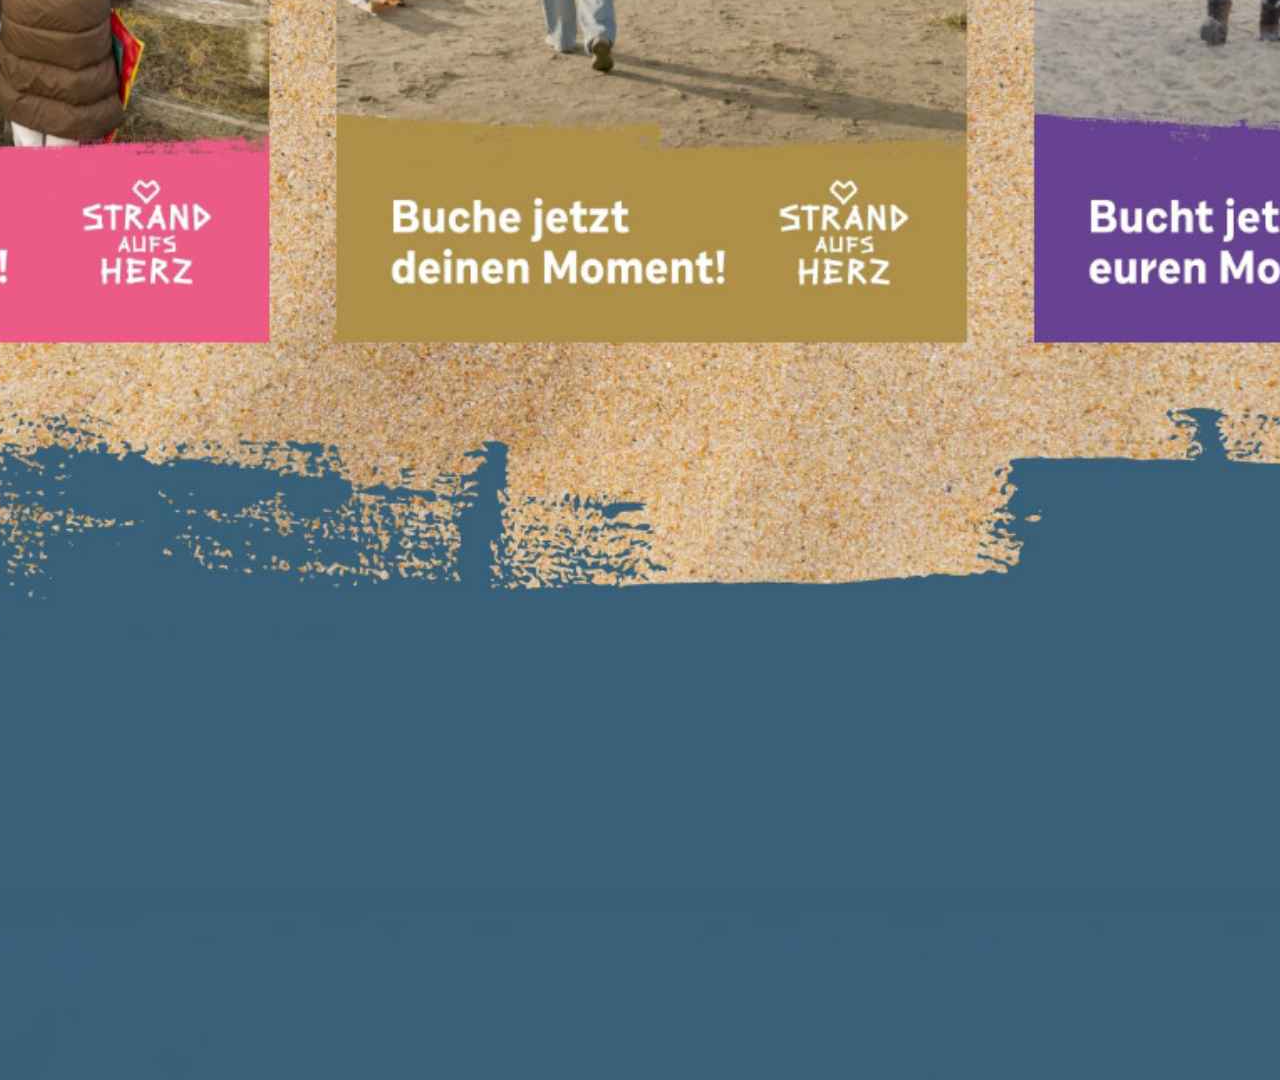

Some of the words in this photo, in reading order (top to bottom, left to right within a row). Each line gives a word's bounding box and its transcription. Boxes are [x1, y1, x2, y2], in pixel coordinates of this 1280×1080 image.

[83, 204, 211, 231] STRAND
[393, 200, 521, 233] Buche
[531, 198, 629, 242] jetzt
[780, 205, 908, 231] STRAND
[1091, 200, 1213, 233] Bucht
[119, 236, 176, 253] AUFS
[816, 236, 874, 253] AUFS
[101, 258, 192, 284] HERZ
[392, 248, 529, 284] deinen
[544, 250, 725, 284] Moment!
[799, 258, 889, 285] HERZ
[1089, 259, 1206, 284] euren
